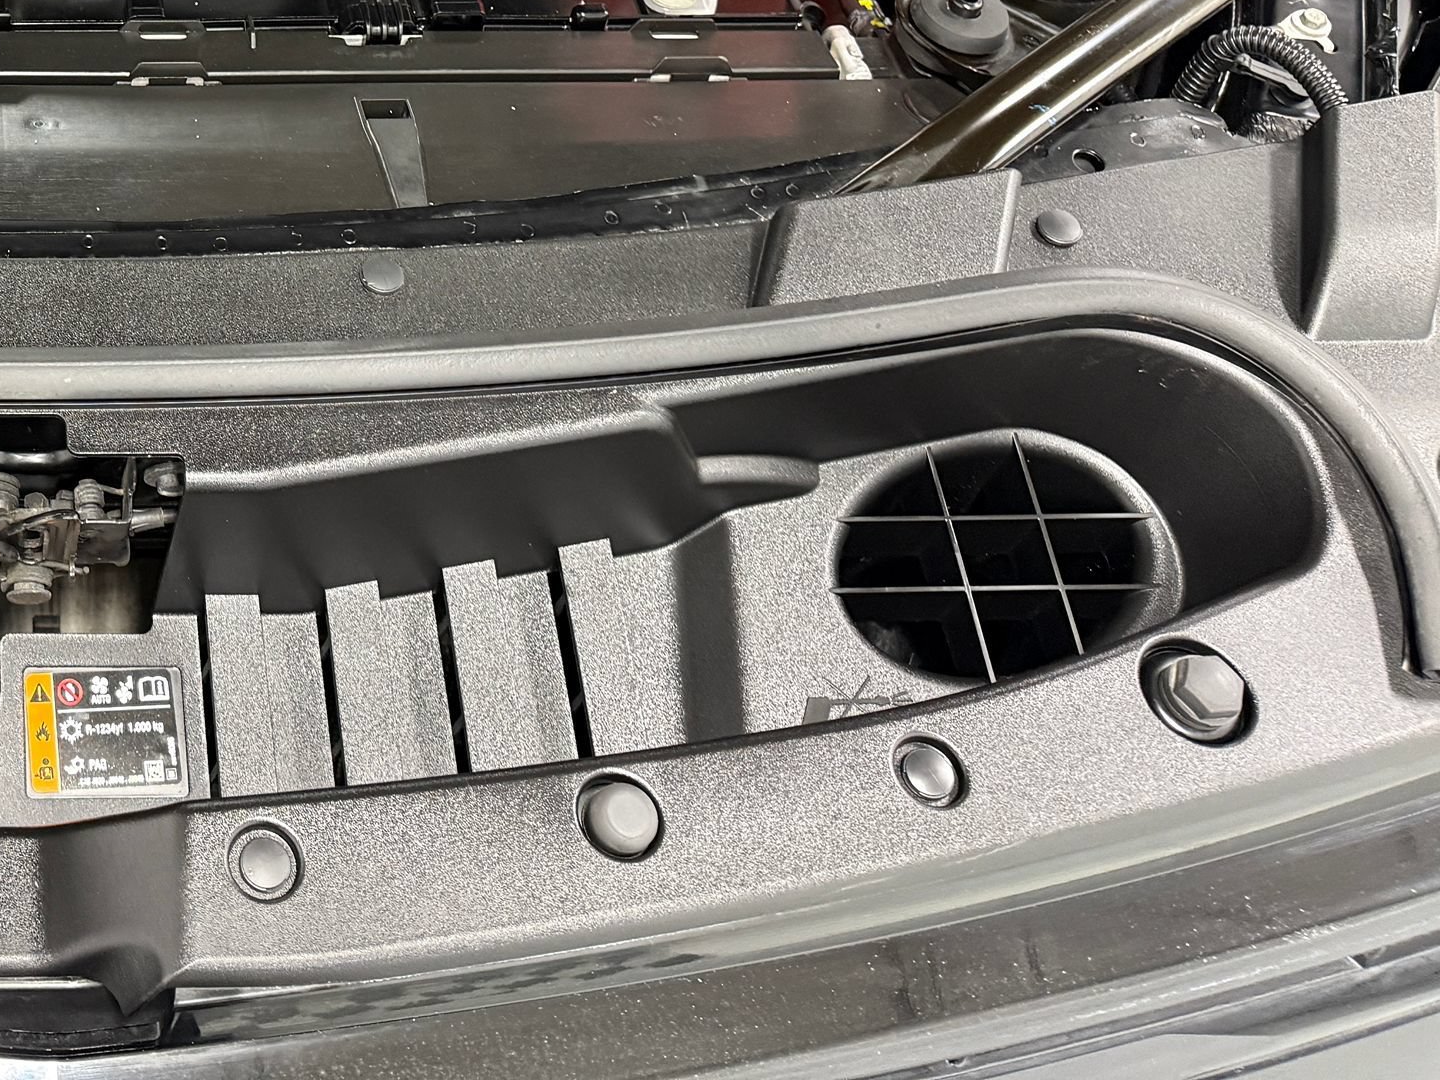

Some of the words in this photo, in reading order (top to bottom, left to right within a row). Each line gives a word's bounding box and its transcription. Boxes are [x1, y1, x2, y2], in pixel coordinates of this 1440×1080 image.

[90, 694, 112, 705] AUTO
[127, 720, 152, 734] 1.000
[152, 720, 165, 734] kg
